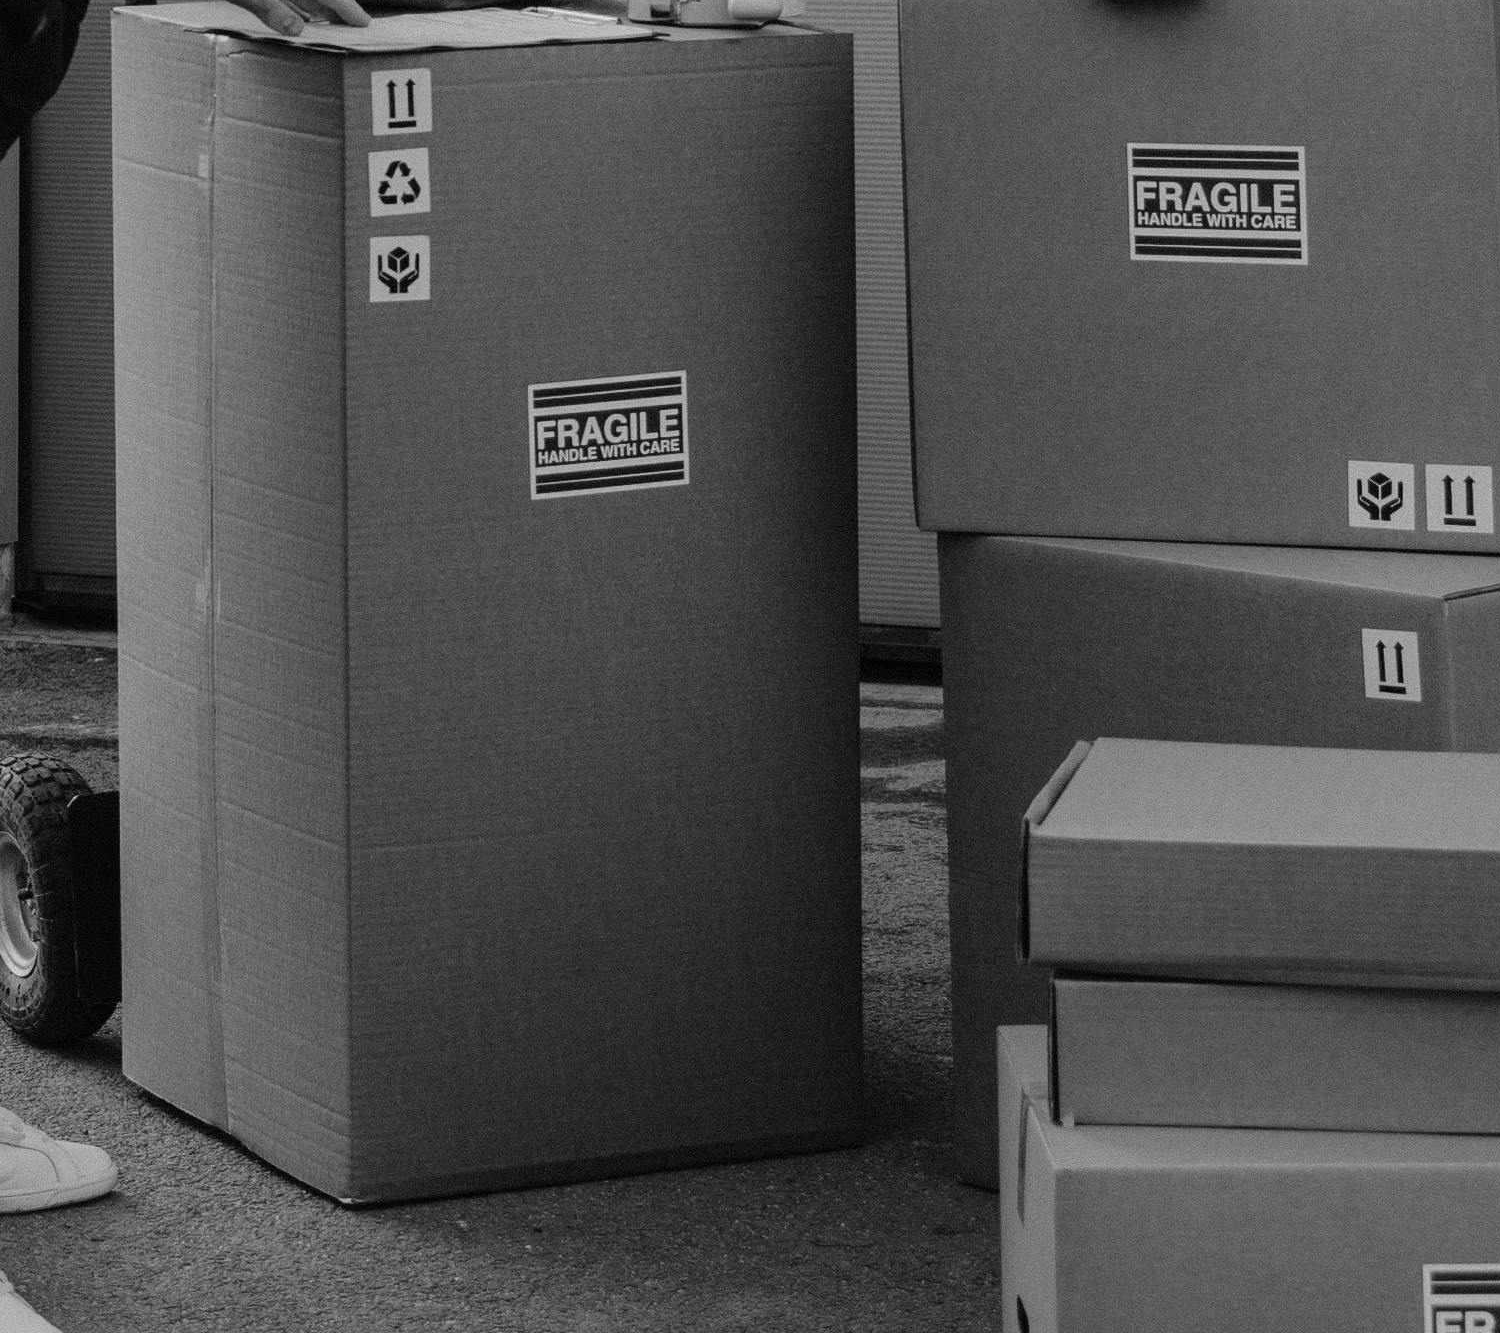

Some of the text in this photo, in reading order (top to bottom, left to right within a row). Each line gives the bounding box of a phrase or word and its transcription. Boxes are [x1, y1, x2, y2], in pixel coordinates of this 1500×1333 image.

[1136, 180, 1297, 214] FRAGILE
[1137, 211, 1297, 229] HANDLE WITH CARE
[536, 408, 680, 450] FRAGILE
[538, 438, 680, 465] HANDLE WITH CARE
